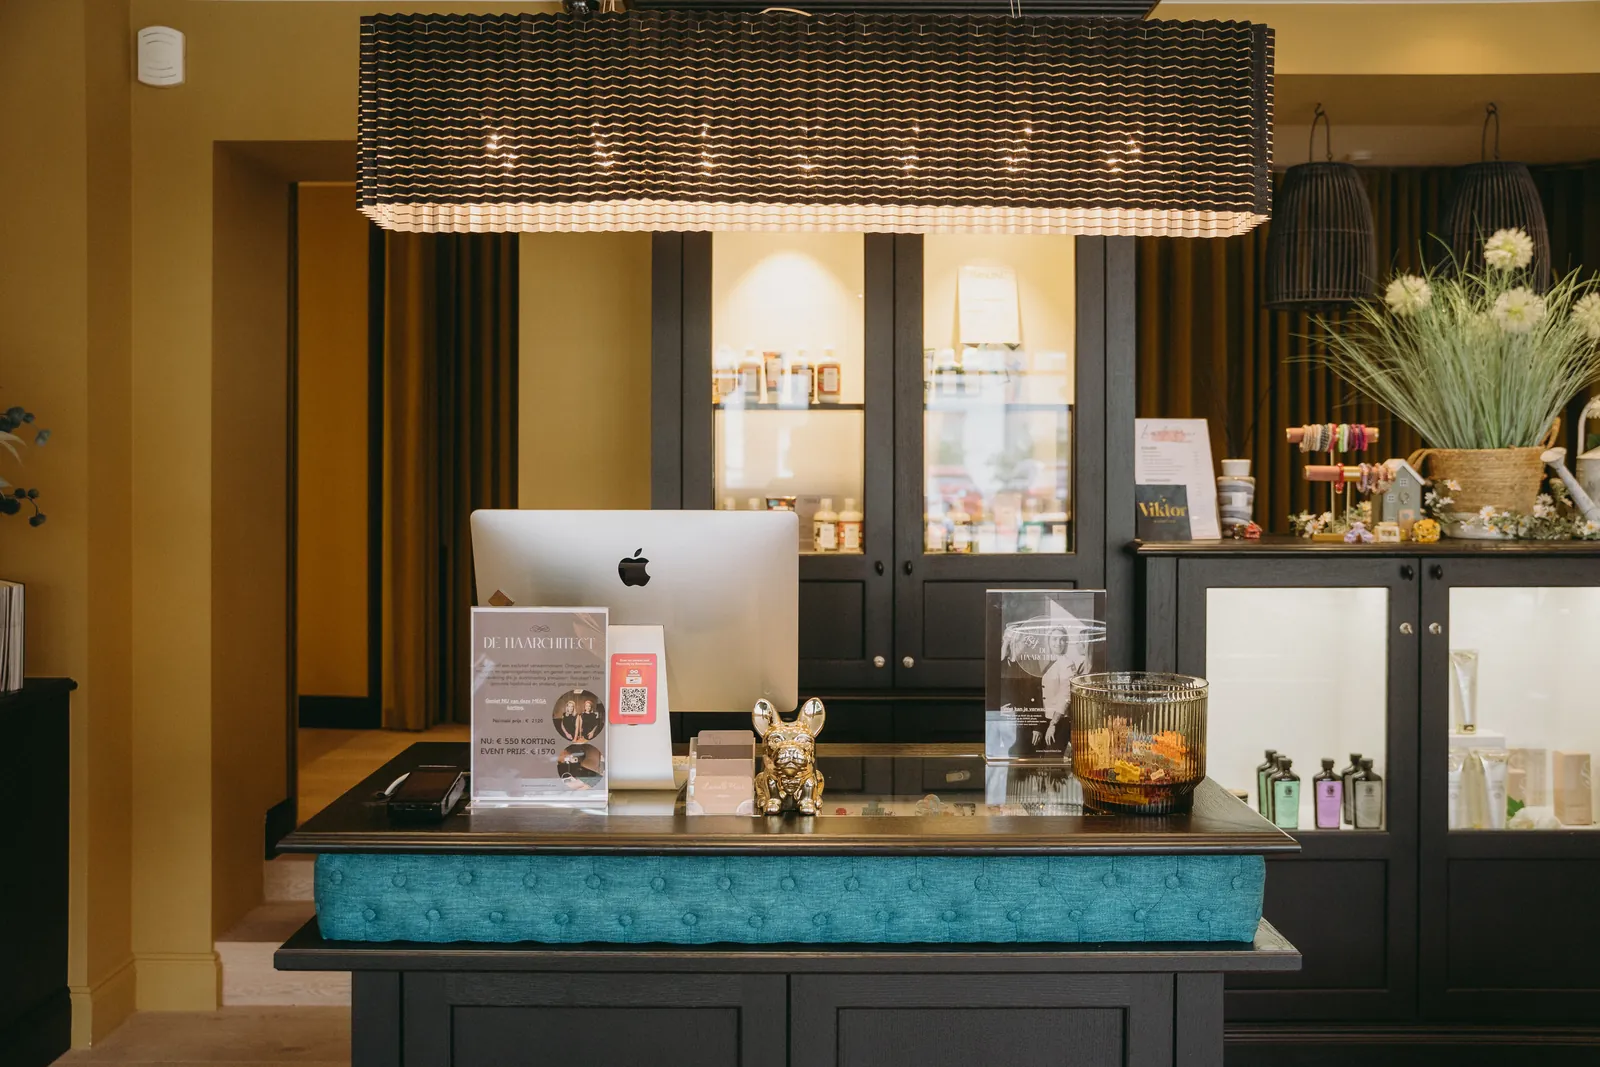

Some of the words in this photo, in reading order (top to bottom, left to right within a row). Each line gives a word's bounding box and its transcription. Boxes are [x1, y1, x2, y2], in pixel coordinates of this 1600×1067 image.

[1138, 501, 1187, 517] Viktor
[483, 637, 501, 649] DE
[505, 637, 596, 649] HAARCHITECT
[480, 737, 495, 745] NU:
[496, 737, 502, 745] €
[504, 737, 520, 745] 550
[520, 737, 556, 745] KORTING
[480, 747, 505, 755] EVENT
